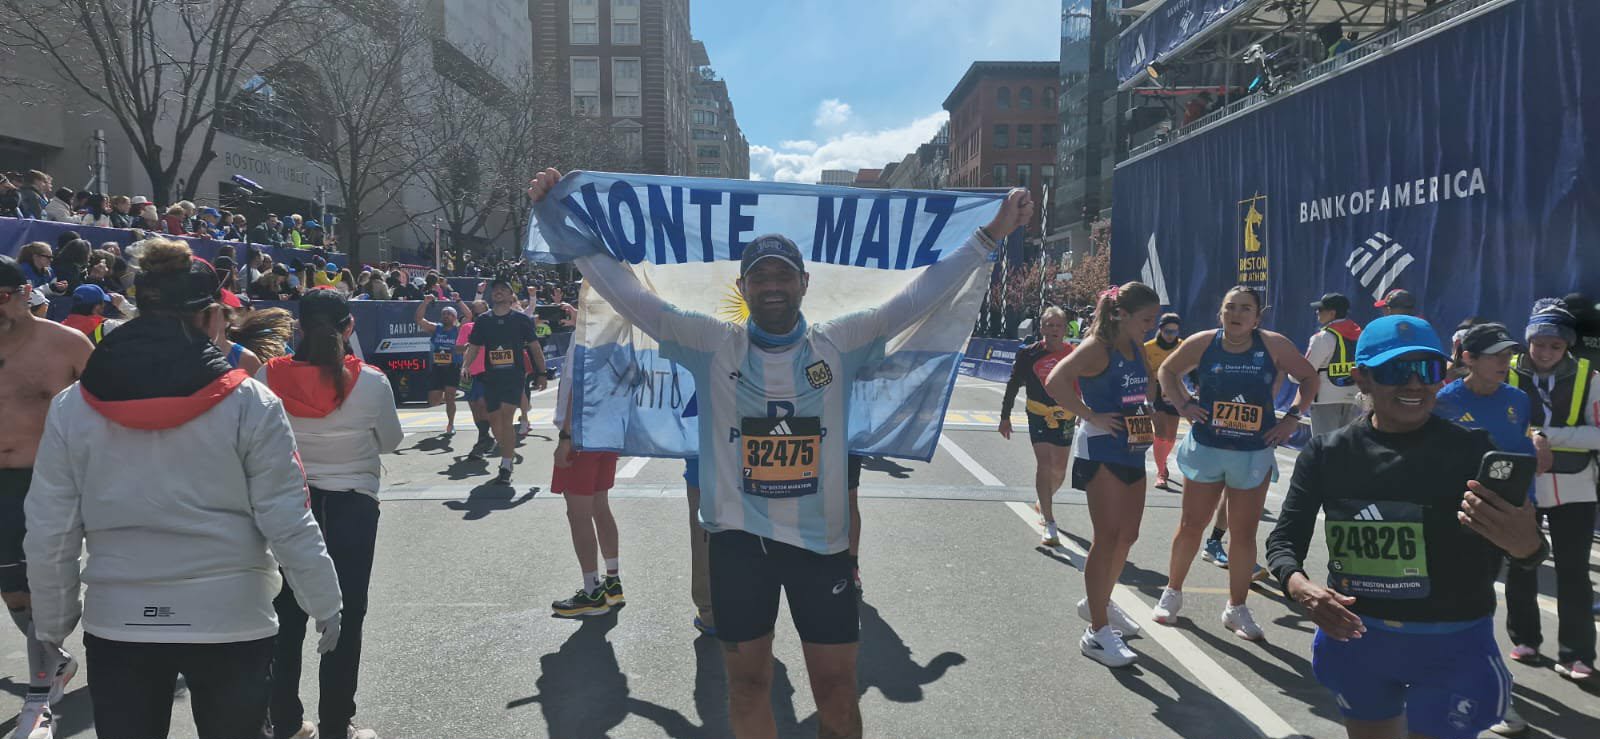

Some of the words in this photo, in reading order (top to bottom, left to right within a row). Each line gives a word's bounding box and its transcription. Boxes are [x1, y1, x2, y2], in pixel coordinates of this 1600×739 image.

[225, 152, 271, 175] BOSTON
[1300, 194, 1346, 223] BANK
[1350, 189, 1375, 215] OF
[1379, 167, 1486, 211] AMERICA
[560, 180, 759, 265] MONTE
[811, 194, 958, 271] MAIZ
[389, 322, 407, 335] BANK
[1215, 403, 1259, 424] 27159
[746, 439, 815, 467] 32475
[1331, 525, 1417, 560] 24826
[1362, 580, 1385, 589] BOSTON
